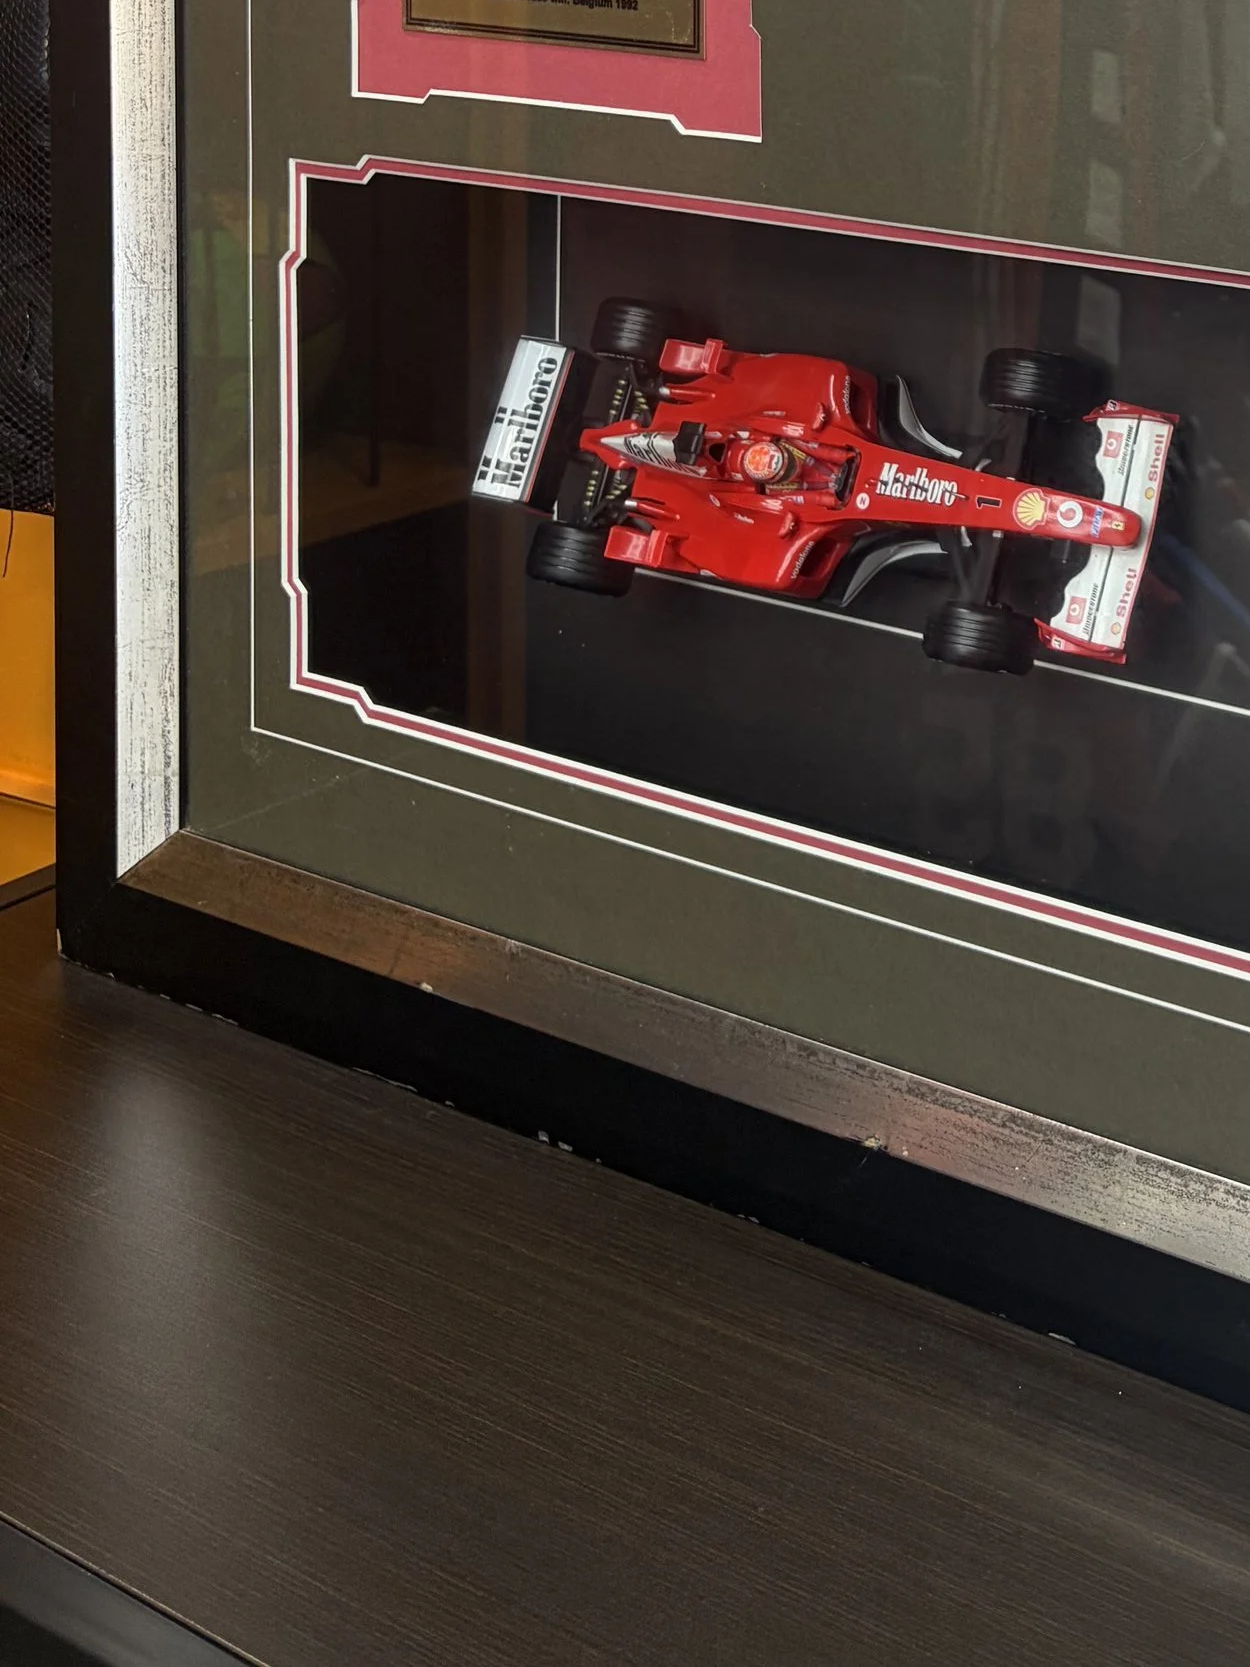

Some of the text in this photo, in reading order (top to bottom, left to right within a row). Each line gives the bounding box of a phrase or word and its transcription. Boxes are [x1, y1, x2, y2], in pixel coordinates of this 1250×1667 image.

[477, 356, 558, 491] Marlboro
[1148, 434, 1165, 482] Shell
[876, 462, 958, 506] Marlboro
[1116, 568, 1137, 618] Shell
